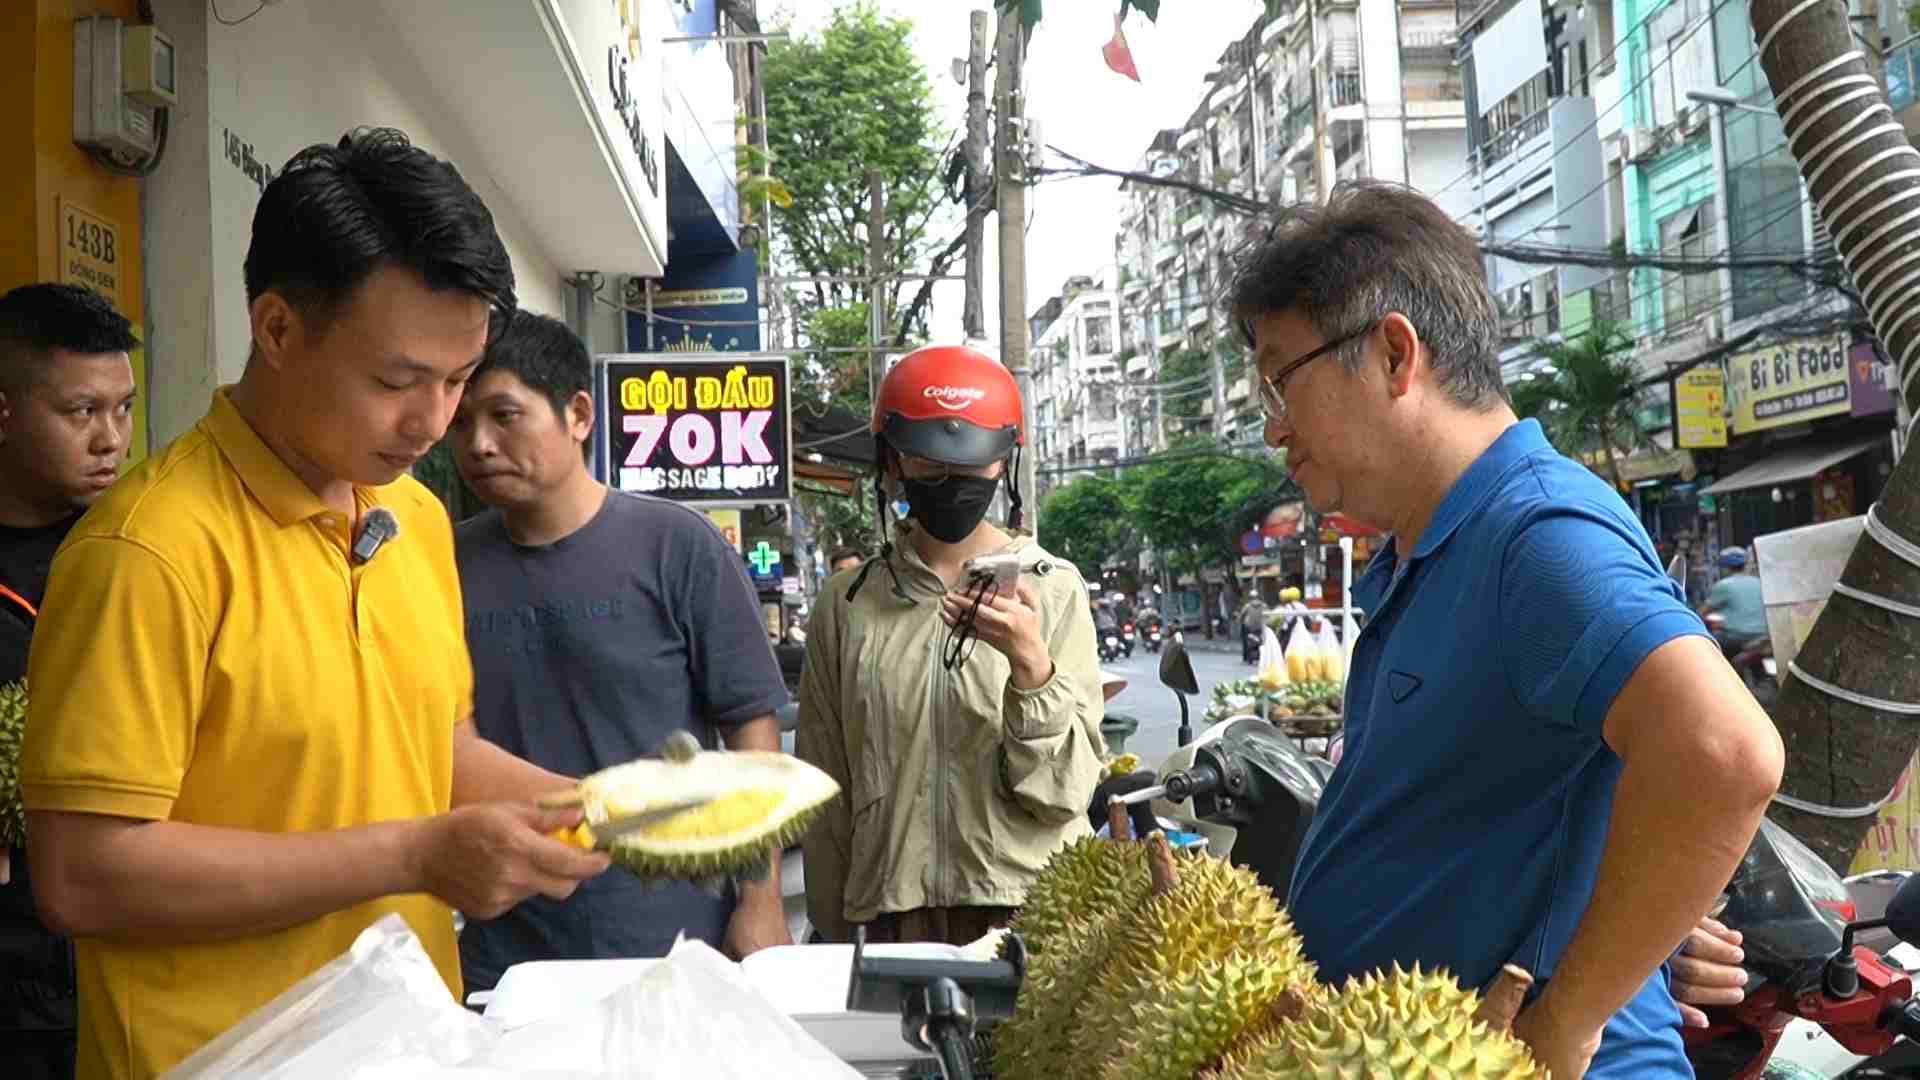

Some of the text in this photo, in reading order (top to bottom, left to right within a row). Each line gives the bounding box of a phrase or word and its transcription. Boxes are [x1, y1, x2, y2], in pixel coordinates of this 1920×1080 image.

[67, 214, 115, 264] 143B
[621, 370, 687, 415] GỘI
[923, 384, 985, 400] Colgate
[1751, 359, 1767, 390] Bi
[1774, 352, 1790, 384] Bi
[622, 411, 773, 466] 70K
